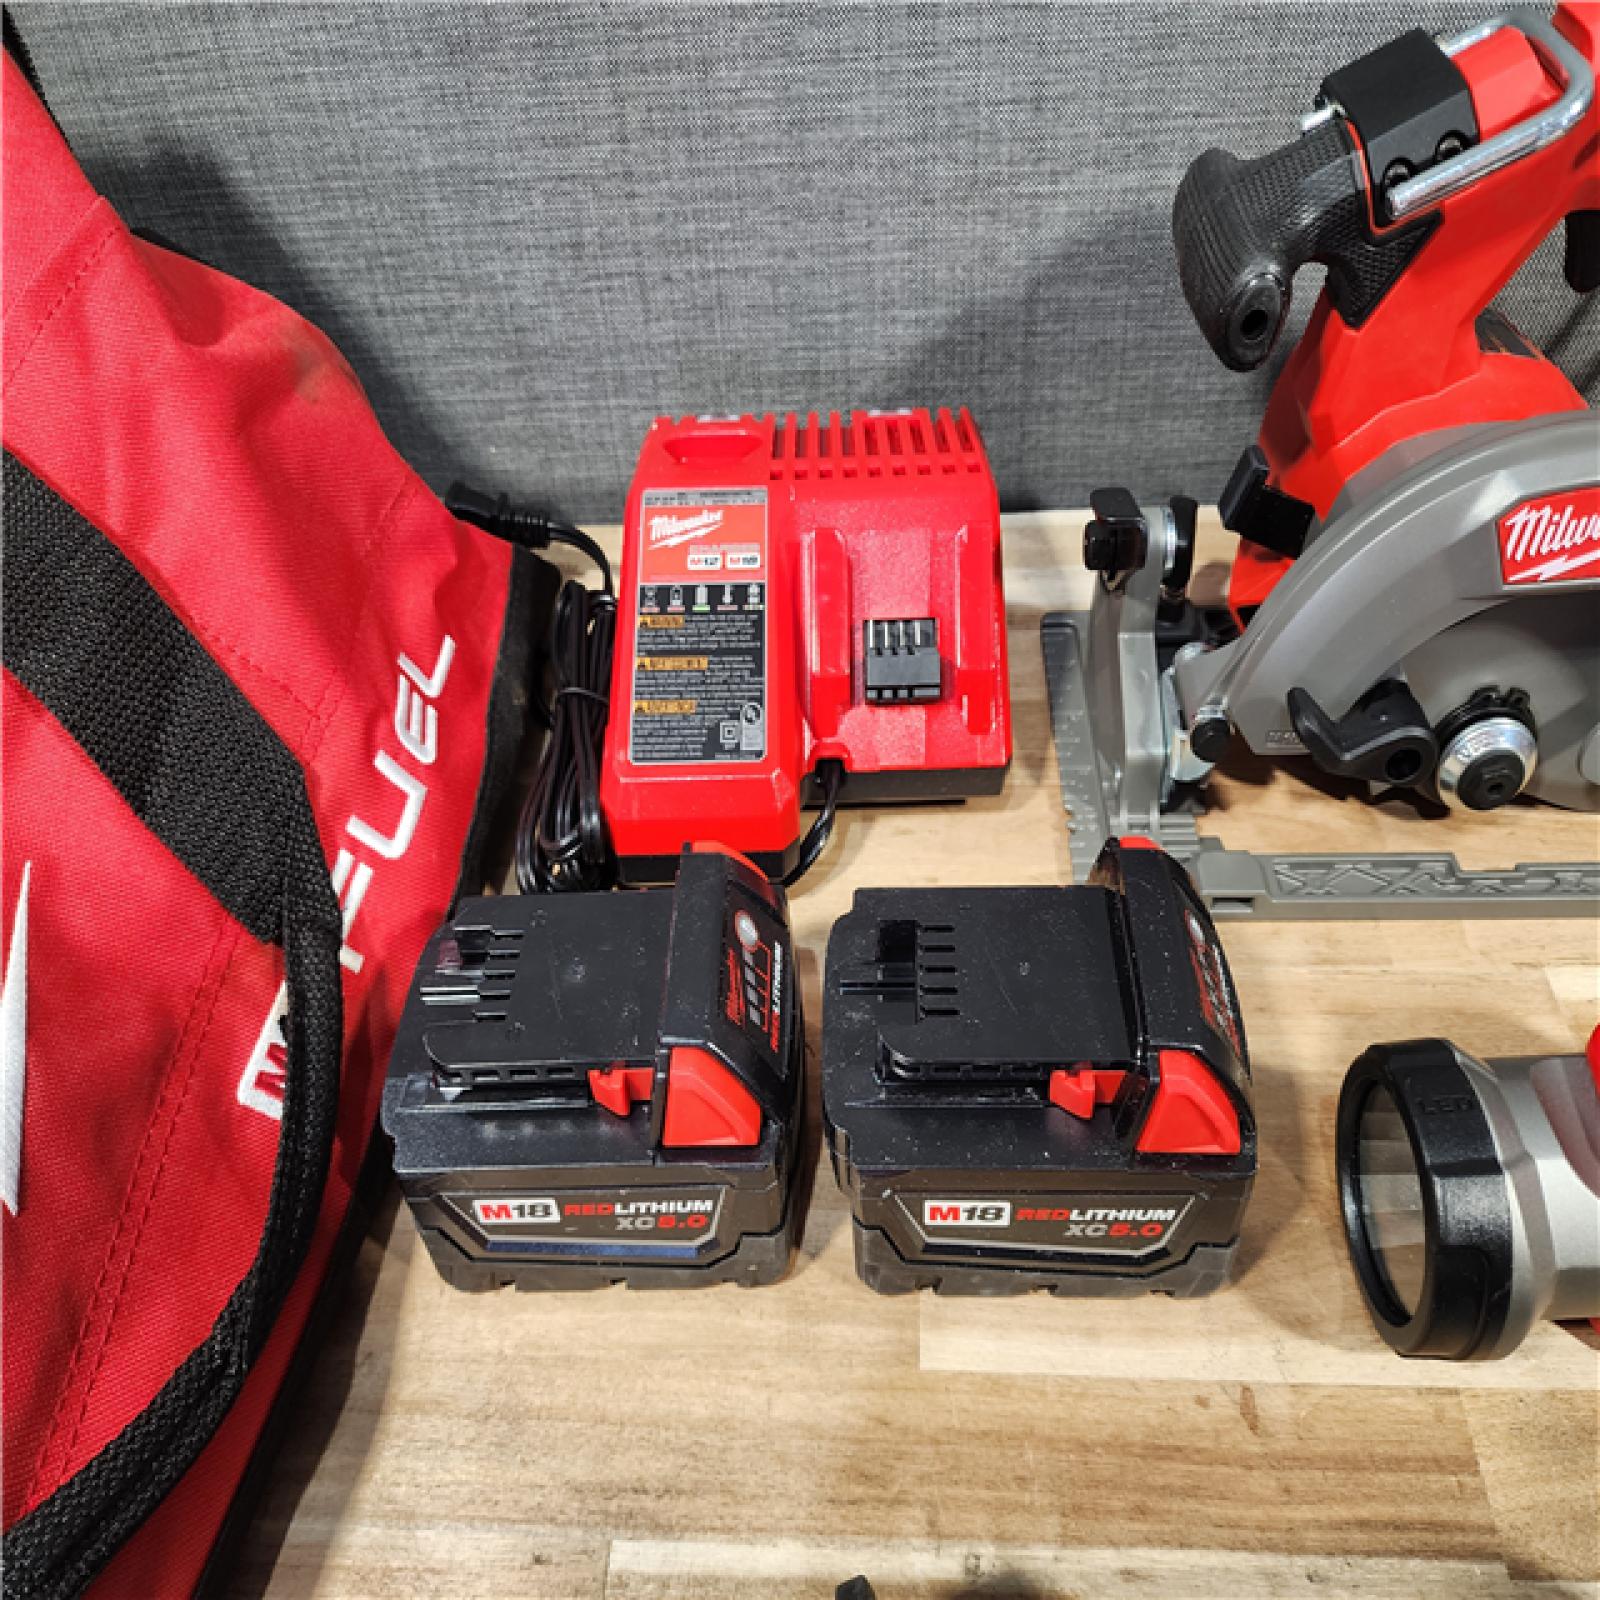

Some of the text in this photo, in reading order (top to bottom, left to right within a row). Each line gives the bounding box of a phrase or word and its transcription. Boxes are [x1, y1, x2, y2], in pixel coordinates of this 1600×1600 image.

[331, 634, 456, 974] FUEL
[480, 1200, 713, 1220] M18 REDLITHIUM
[929, 1205, 1176, 1221] M18 REDLITHIUM
